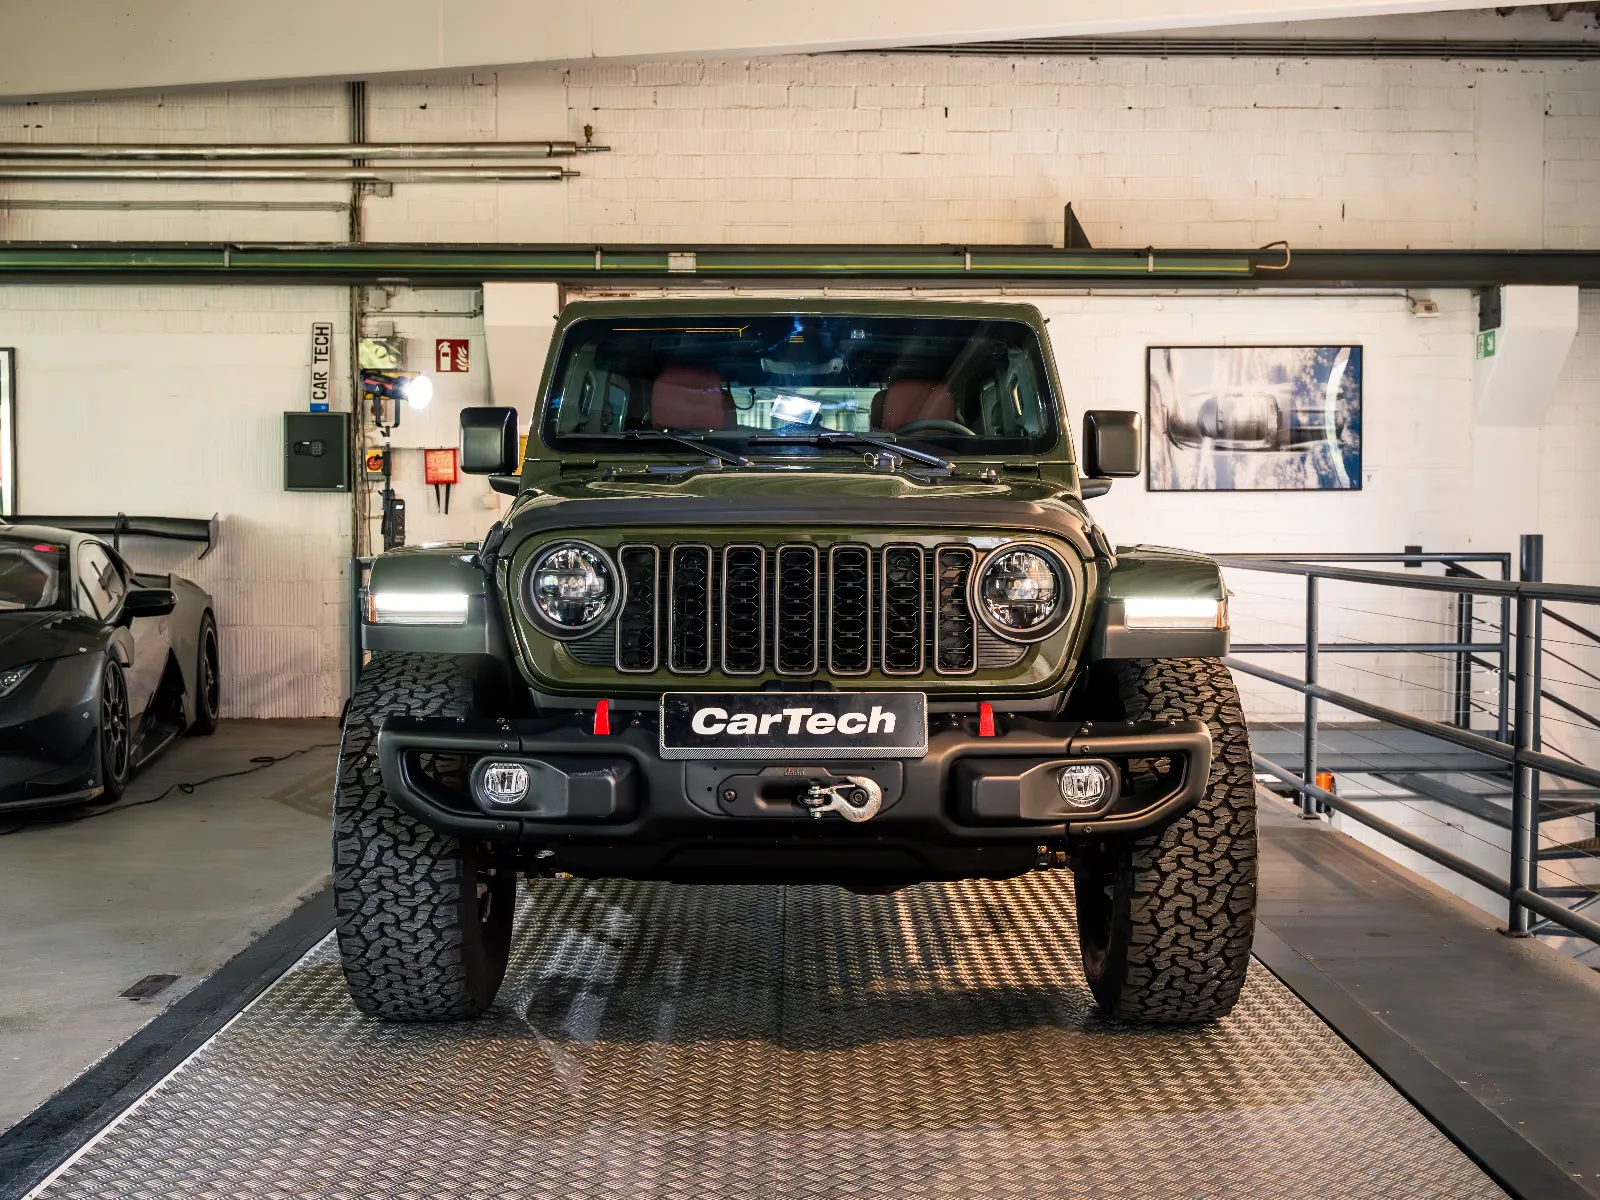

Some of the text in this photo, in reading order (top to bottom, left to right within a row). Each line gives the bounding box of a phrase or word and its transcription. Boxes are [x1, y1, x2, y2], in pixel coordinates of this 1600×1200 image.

[312, 326, 329, 400] CAR TECH
[691, 706, 896, 735] CarTech
